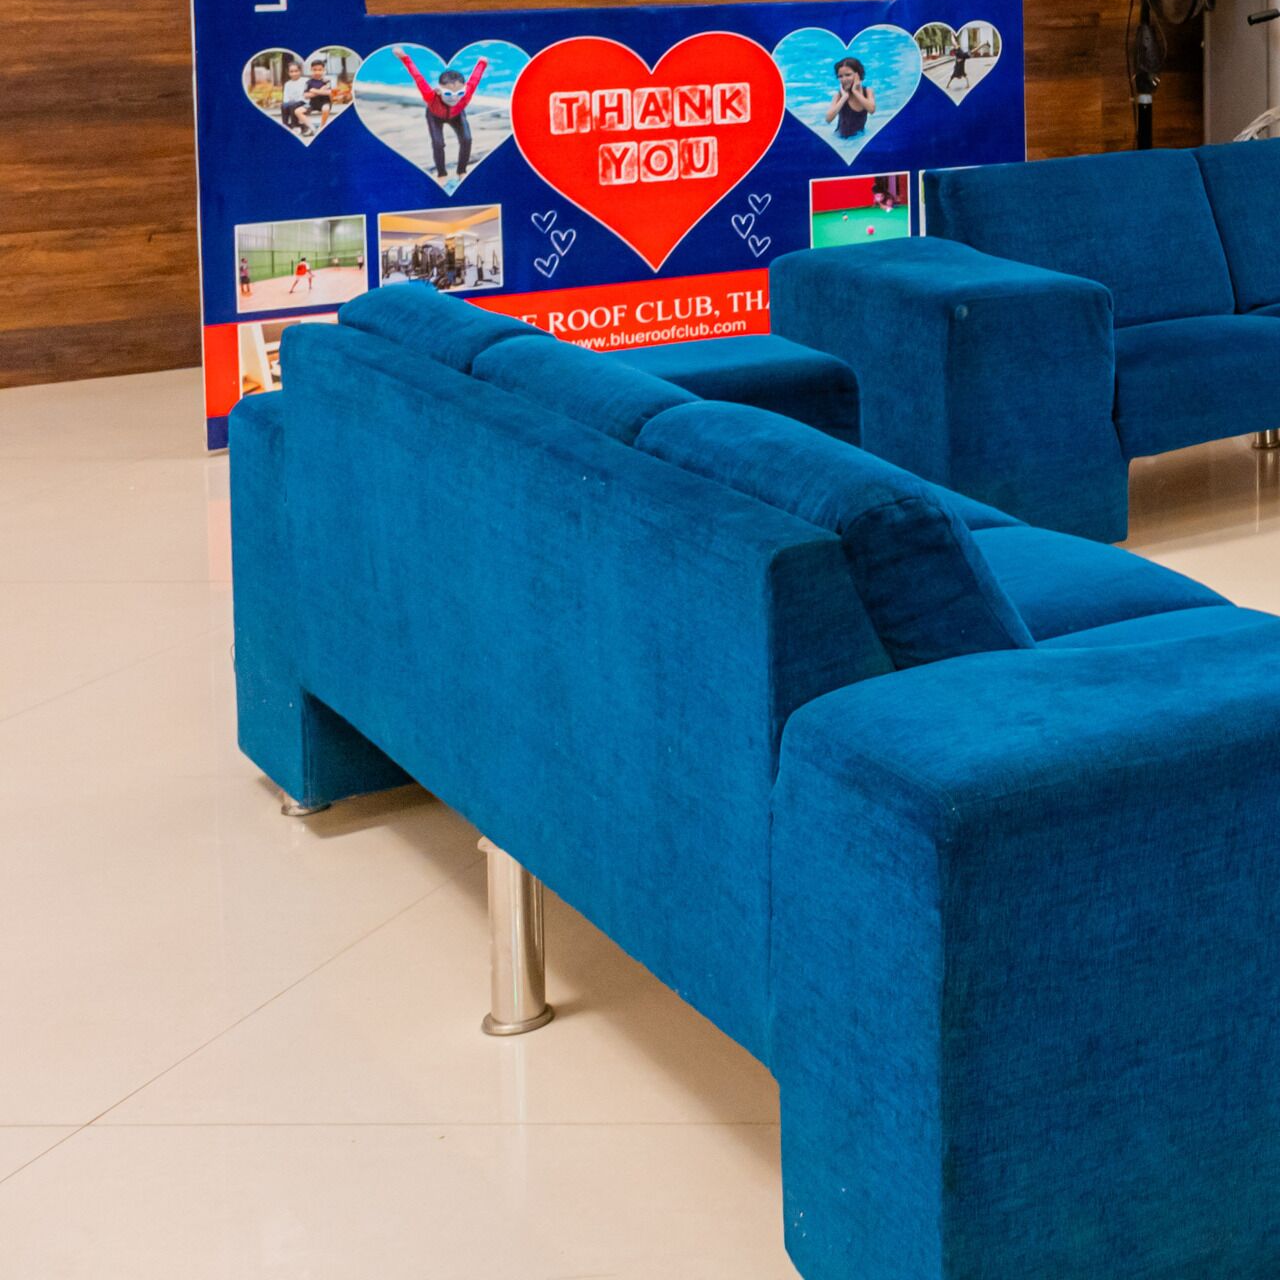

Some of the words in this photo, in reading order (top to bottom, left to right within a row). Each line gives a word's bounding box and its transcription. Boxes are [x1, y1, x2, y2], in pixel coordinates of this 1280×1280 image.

[555, 86, 747, 131] THANK
[602, 138, 714, 182] YOU
[549, 304, 628, 334] ROOF
[635, 295, 721, 324] CLUB,
[726, 290, 770, 312] TH
